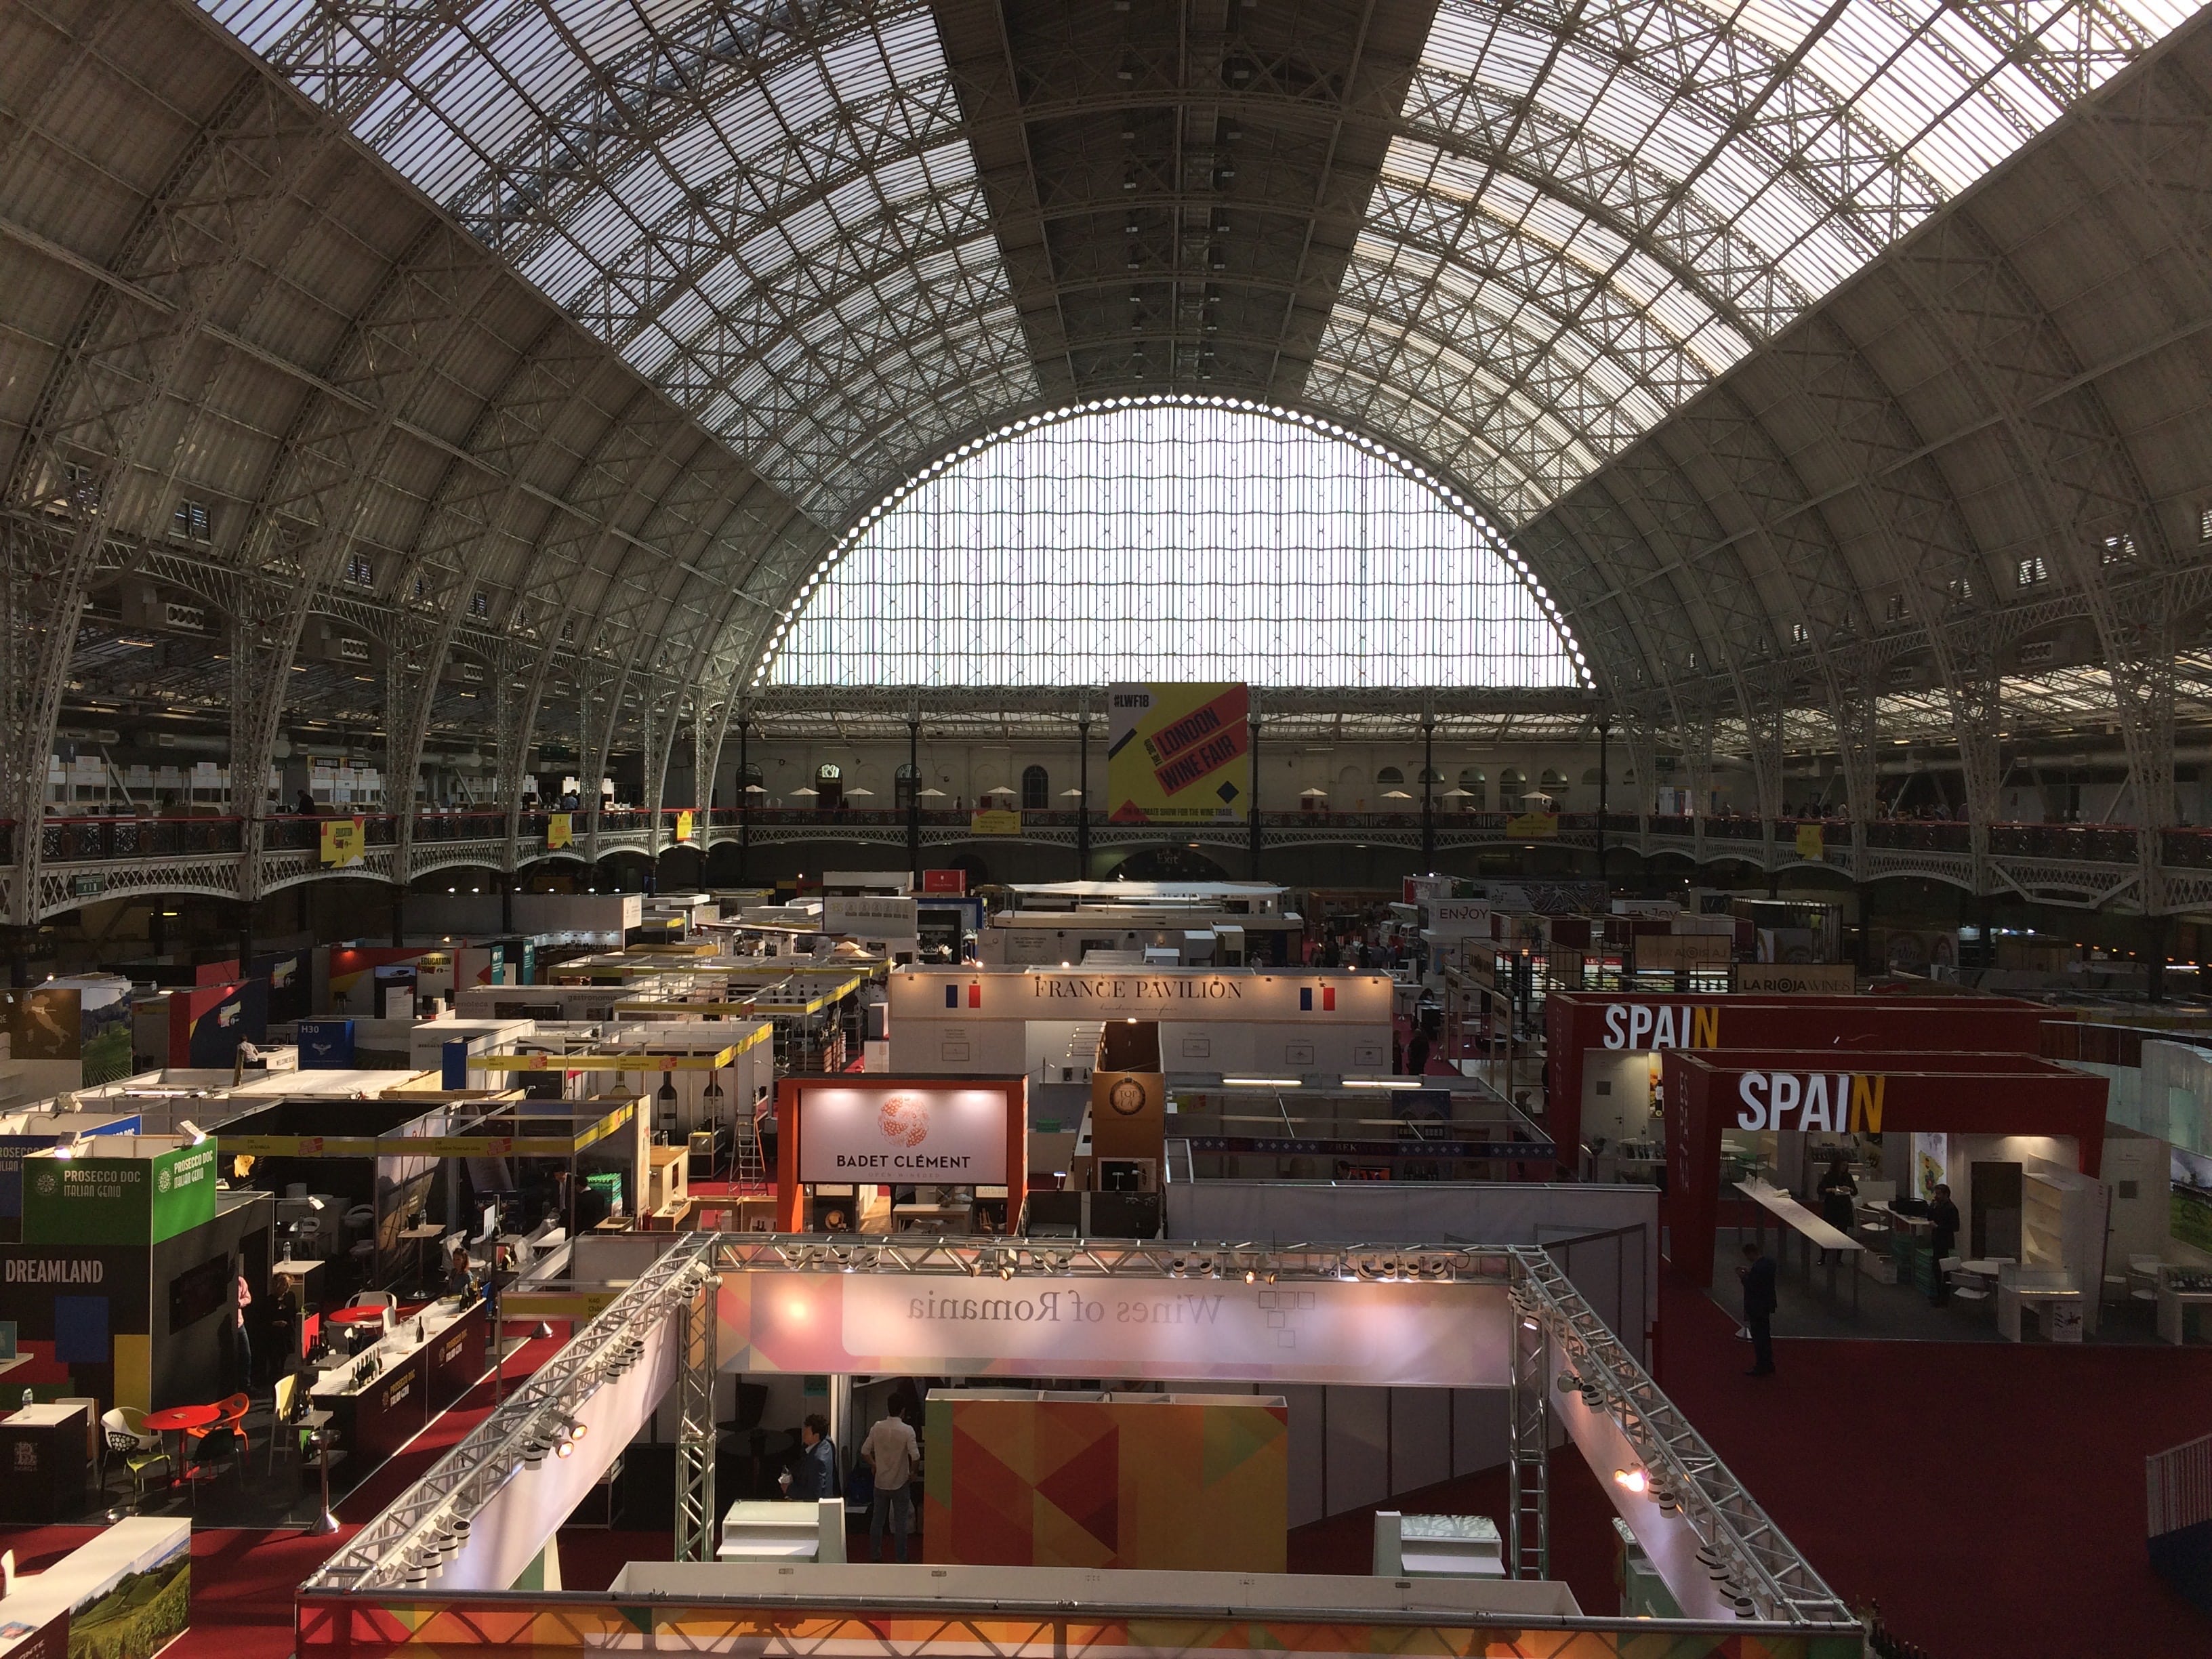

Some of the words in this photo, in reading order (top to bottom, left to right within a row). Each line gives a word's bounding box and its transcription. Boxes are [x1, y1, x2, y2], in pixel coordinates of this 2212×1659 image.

[1113, 695, 1149, 708] #LWF18
[1157, 707, 1221, 756] LONDON
[1159, 754, 1204, 791] WINE
[1199, 735, 1237, 769] FAIR
[1216, 808, 1233, 817] TRADE
[1157, 853, 1179, 864] Exit
[1439, 906, 1488, 920] ENJOY
[421, 957, 452, 966] EDUCATION
[1035, 981, 1126, 998] FRANCE
[1135, 981, 1242, 999] PAVILION
[1744, 980, 1761, 991] LA
[1763, 978, 1807, 993] RIOJA
[301, 1025, 319, 1033] H30
[1602, 1004, 1720, 1050] SPAIN
[1118, 1089, 1139, 1098] TOP
[1736, 1071, 1886, 1134] SPAIN
[174, 1156, 202, 1174] PROSECCO
[203, 1151, 213, 1164] DOC
[836, 1155, 889, 1167] BADET
[894, 1154, 971, 1168] CLÉMENT
[64, 1170, 117, 1183] PROSECCO
[120, 1170, 141, 1183] DOC
[64, 1185, 95, 1197] ITALIAN
[5, 1259, 104, 1284] DREAMLAND
